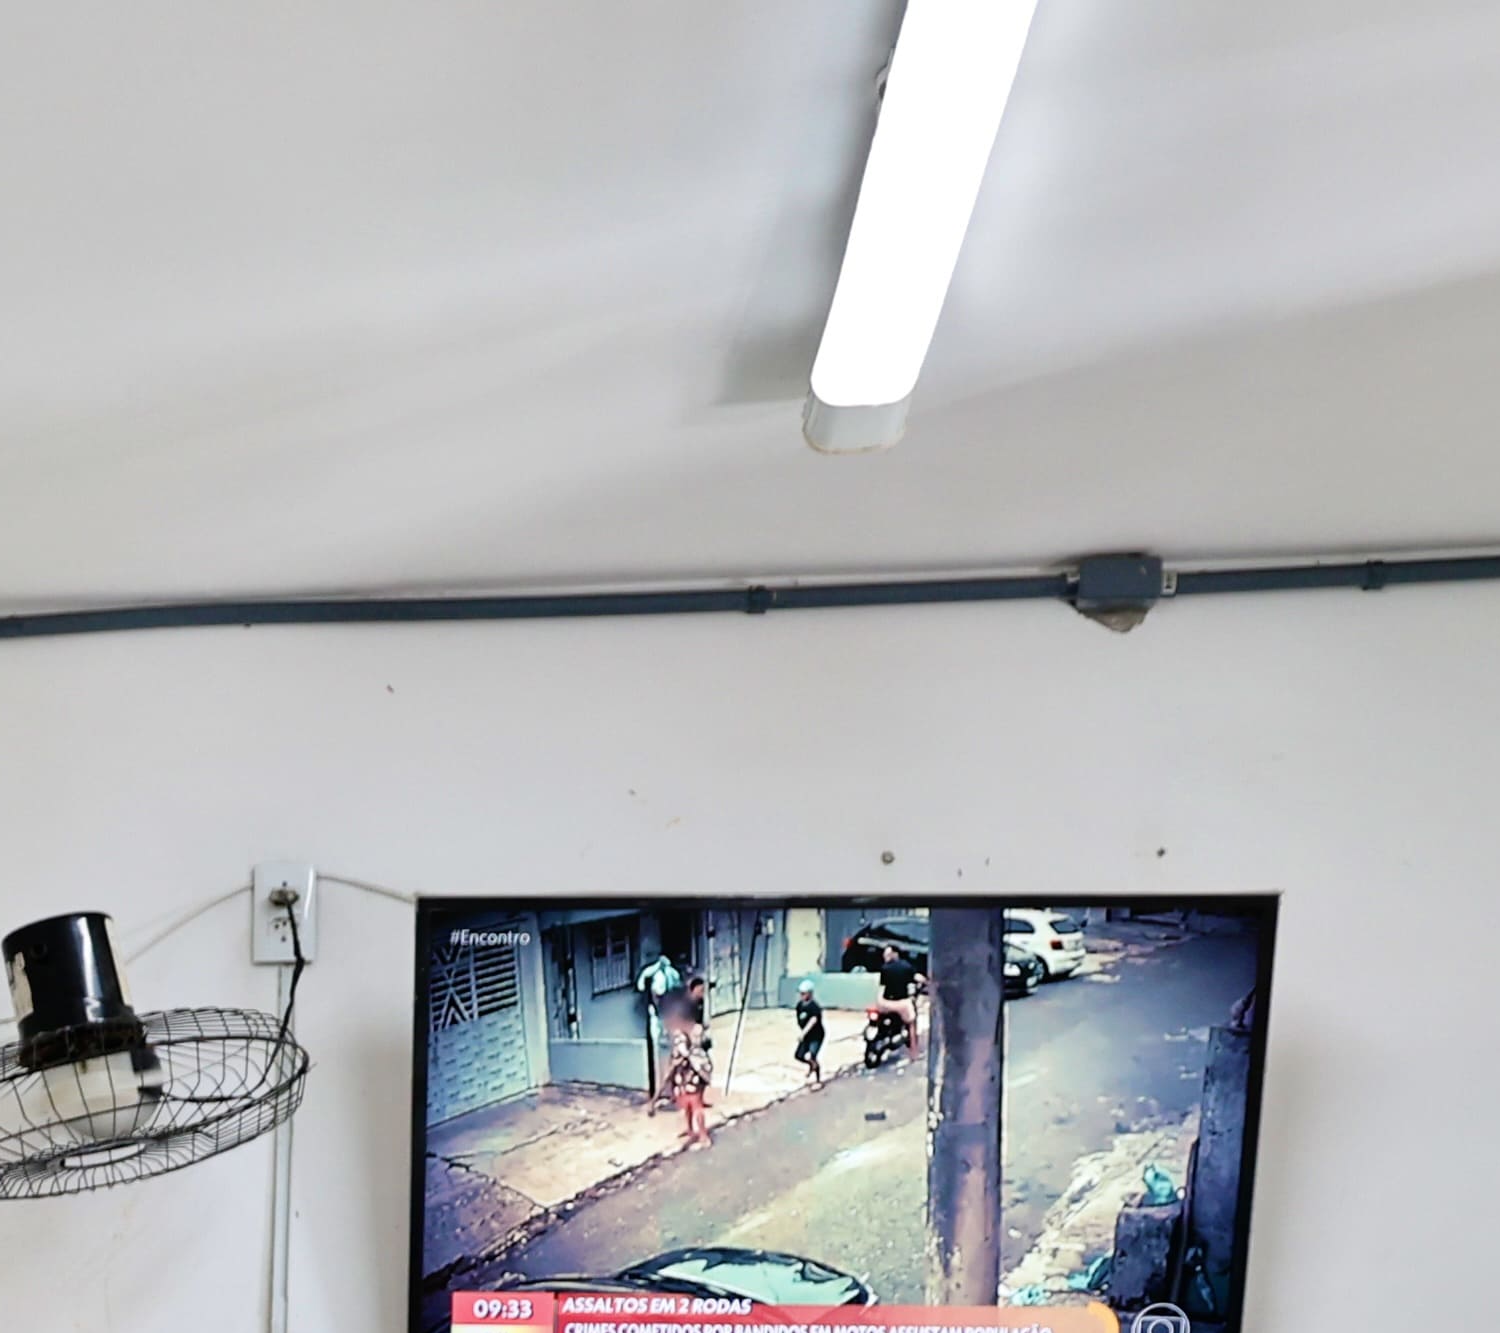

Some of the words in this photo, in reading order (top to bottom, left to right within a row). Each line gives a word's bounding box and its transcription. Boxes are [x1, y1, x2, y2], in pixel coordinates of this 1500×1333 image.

[450, 929, 531, 946] #Encontro
[472, 1299, 533, 1320] 09:33
[562, 1297, 648, 1316] ASSALTOS
[650, 1298, 676, 1316] EM
[677, 1298, 690, 1316] 2
[691, 1298, 752, 1316] RODAS
